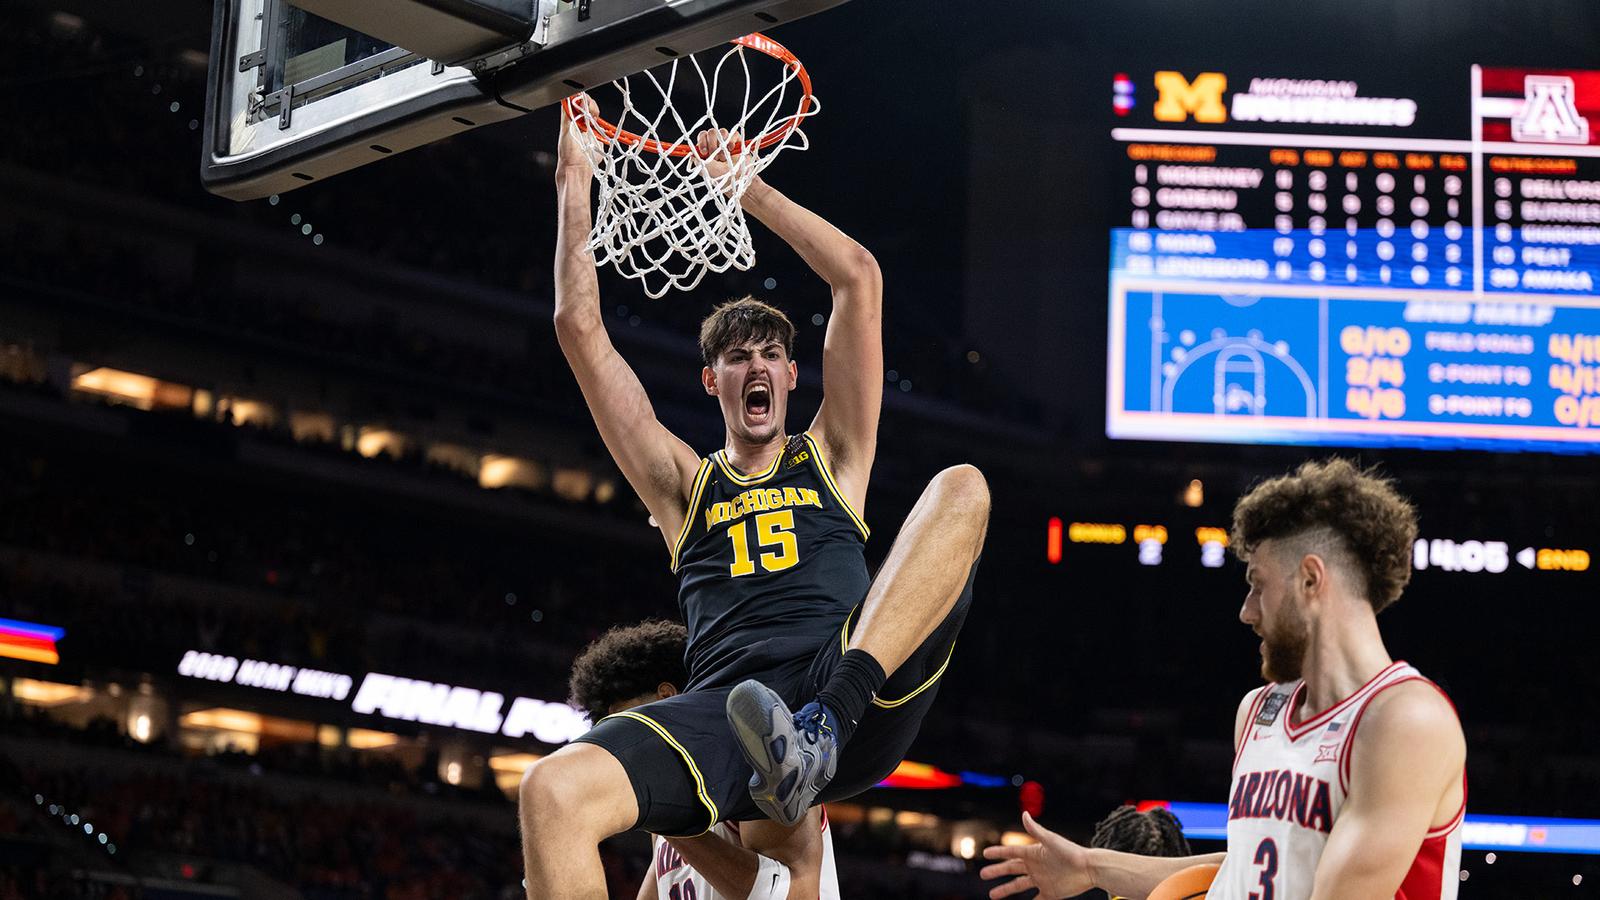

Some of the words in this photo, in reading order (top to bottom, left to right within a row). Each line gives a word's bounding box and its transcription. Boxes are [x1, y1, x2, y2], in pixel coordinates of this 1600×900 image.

[1154, 71, 1227, 123] M
[705, 487, 822, 533] MICHIGAN
[726, 509, 800, 578] 15
[352, 672, 503, 734] FINAL
[1229, 769, 1335, 834] ARIZONA
[1248, 837, 1278, 900] 3
